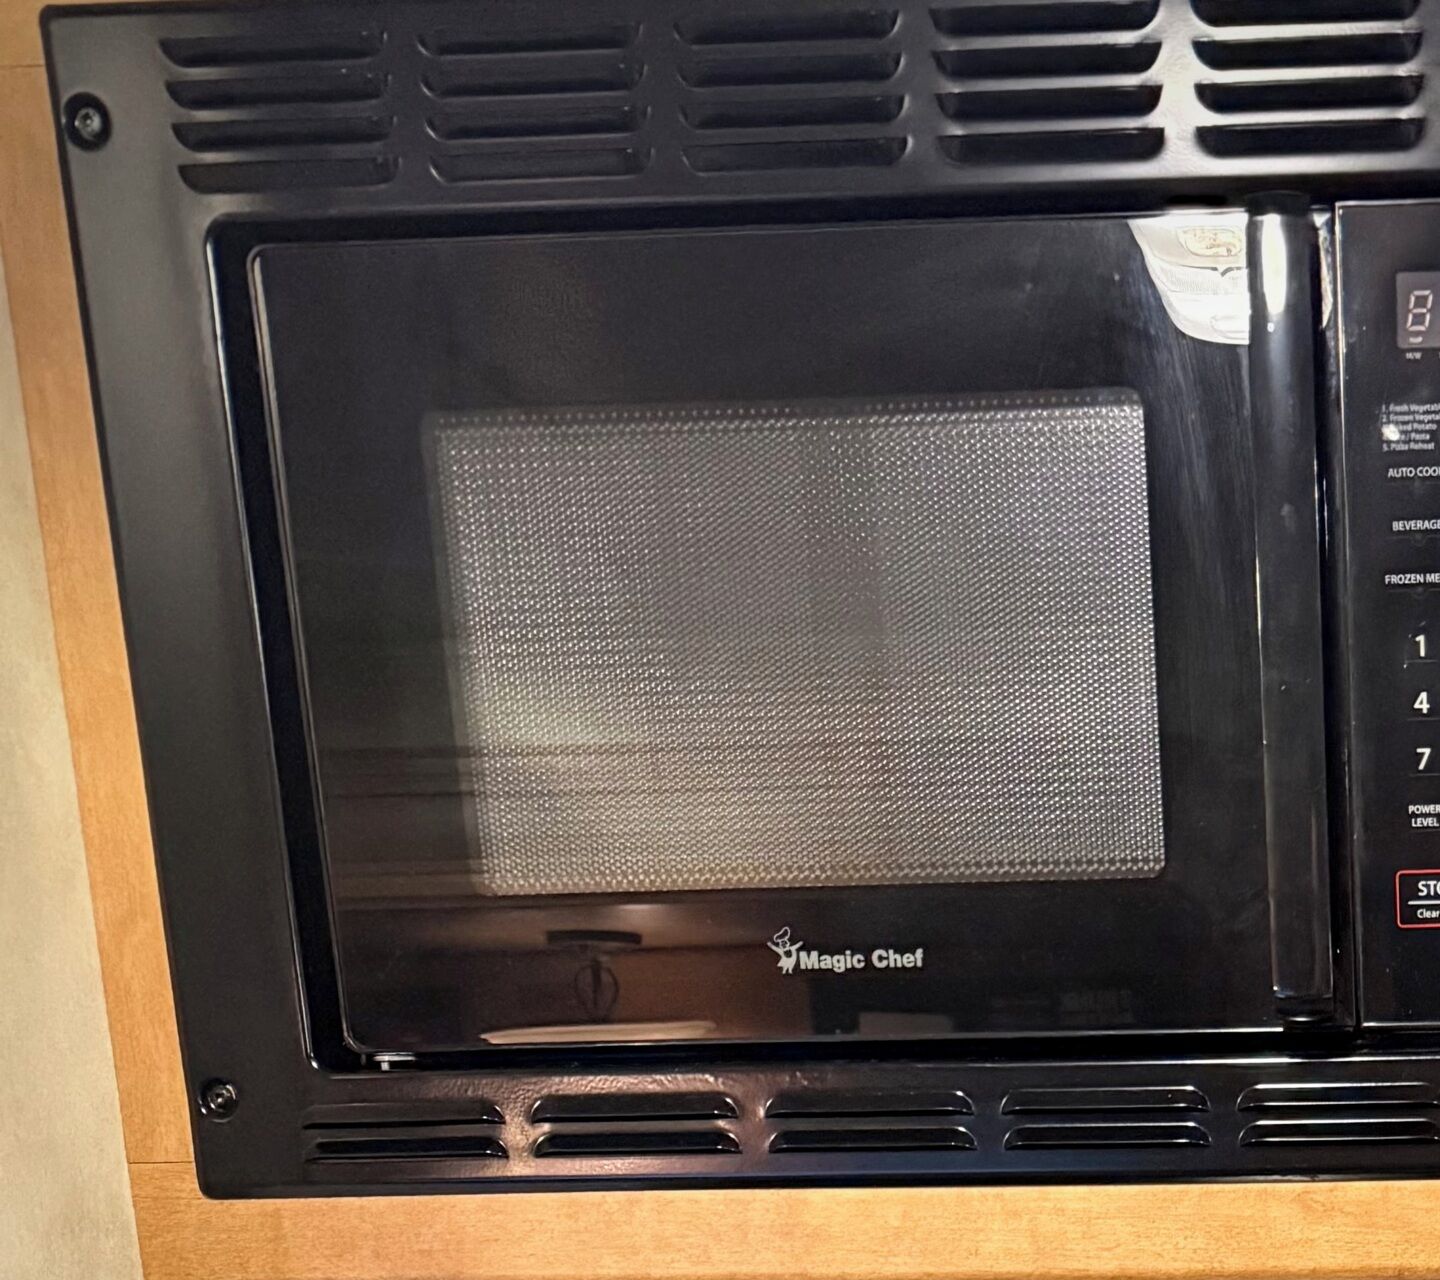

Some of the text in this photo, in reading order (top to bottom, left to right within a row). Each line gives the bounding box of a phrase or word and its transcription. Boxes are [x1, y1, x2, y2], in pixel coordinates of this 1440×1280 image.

[1388, 467, 1415, 478] AUTO
[1385, 573, 1423, 585] FROZEN
[1415, 635, 1427, 657] 1
[1413, 692, 1430, 713] 4
[1416, 748, 1432, 770] 7
[1411, 817, 1439, 828] LEVEL
[1417, 908, 1440, 919] Clear
[799, 947, 924, 973] Magic Chef
